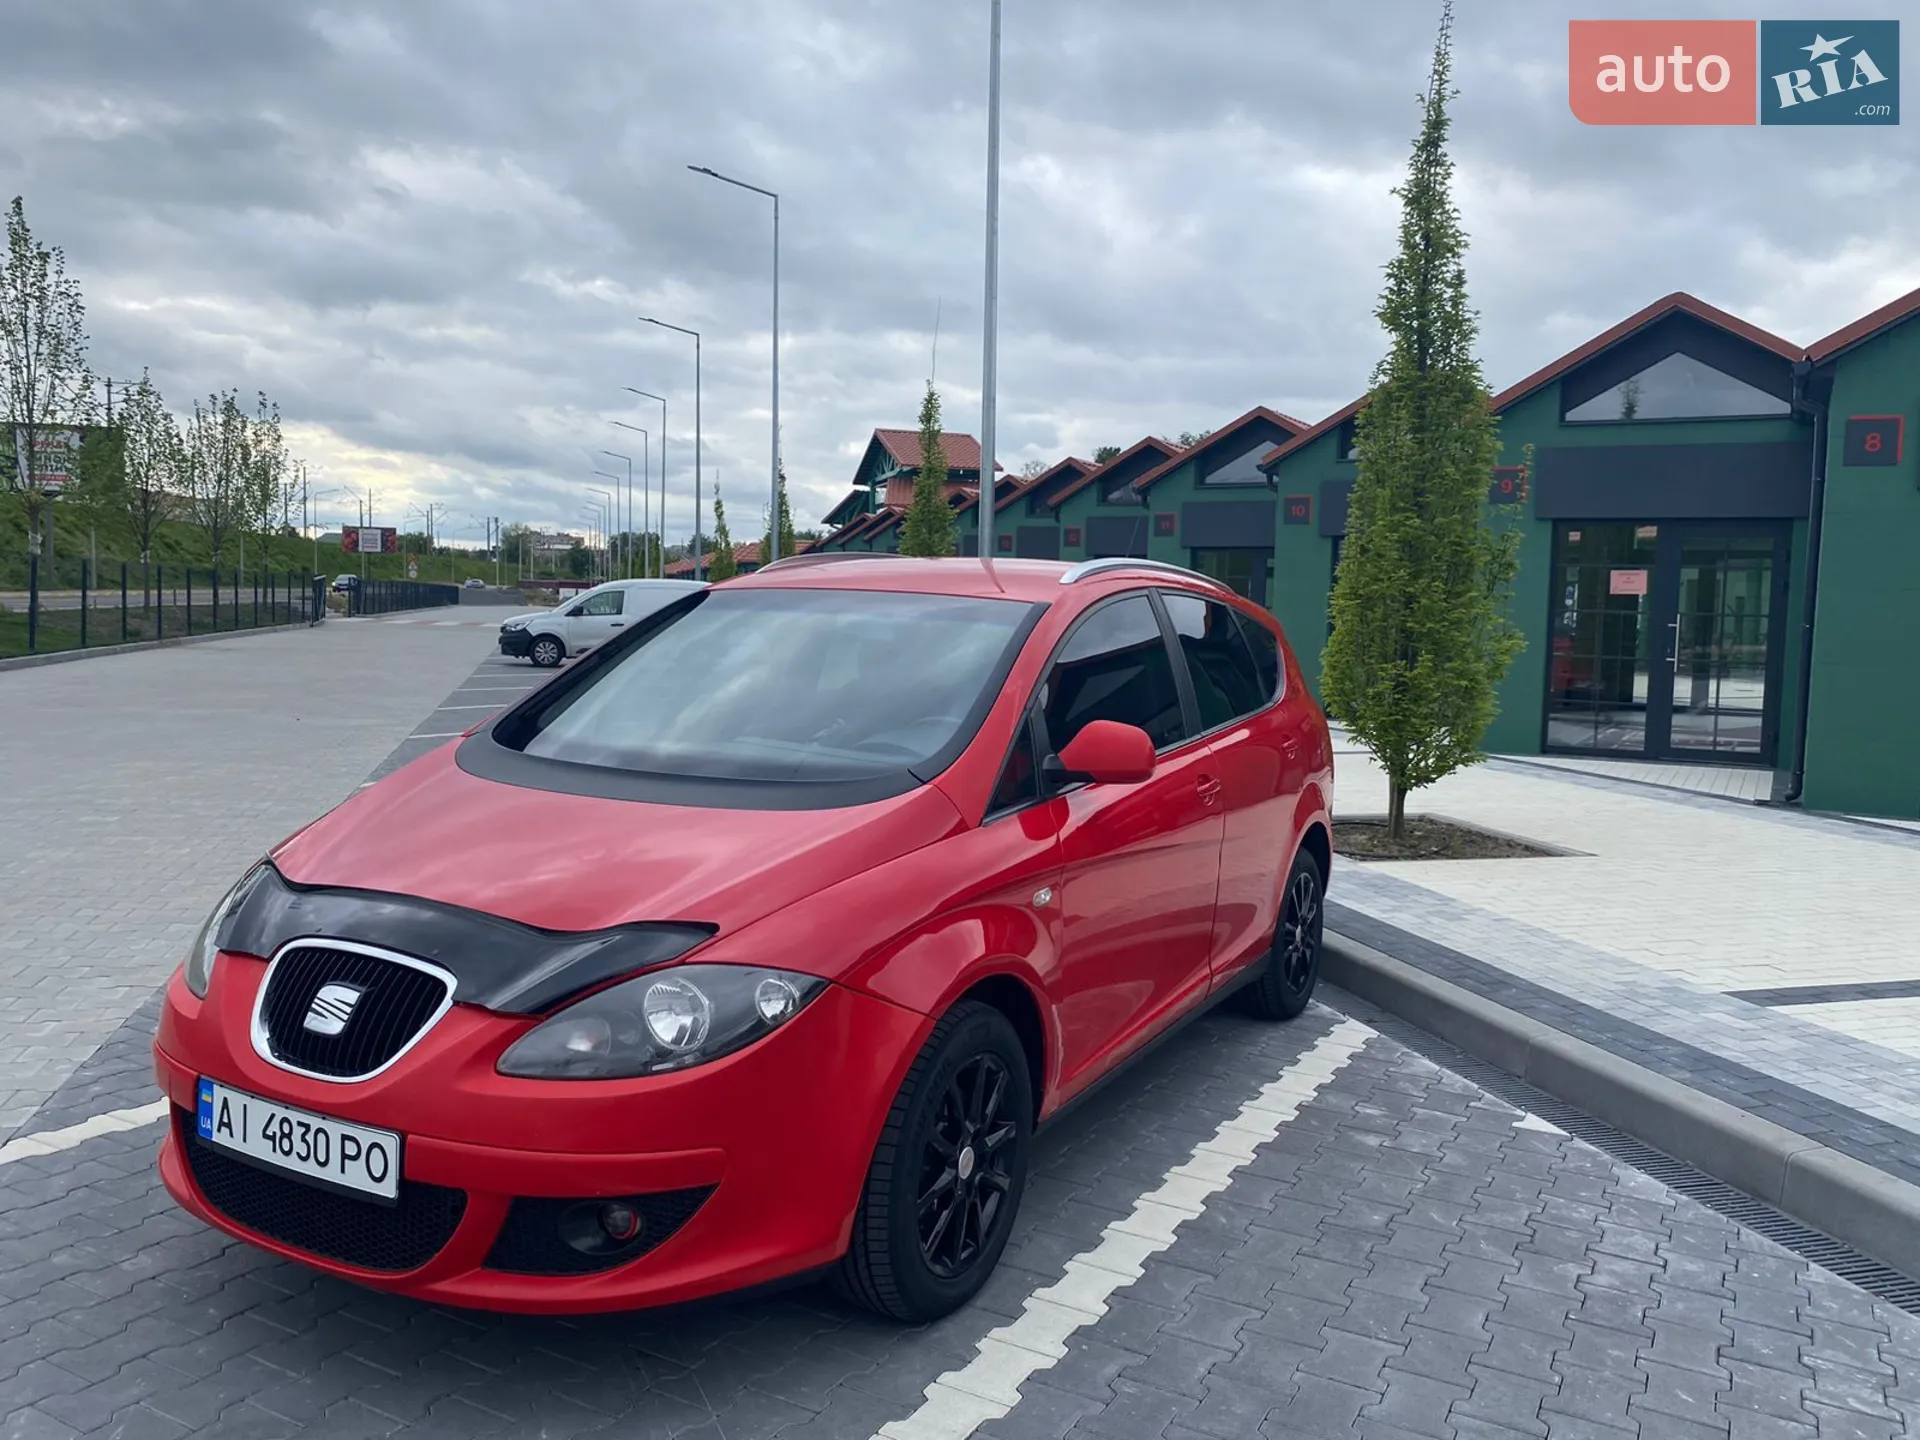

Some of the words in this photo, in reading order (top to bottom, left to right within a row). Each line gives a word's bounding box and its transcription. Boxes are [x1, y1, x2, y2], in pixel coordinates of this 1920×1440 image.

[1865, 433, 1882, 452] 8
[1500, 480, 1512, 495] 9
[1291, 504, 1306, 517] 10
[200, 1116, 212, 1132] UA
[216, 1097, 248, 1143] AI
[262, 1113, 331, 1168] 4830
[340, 1133, 389, 1183] PO
